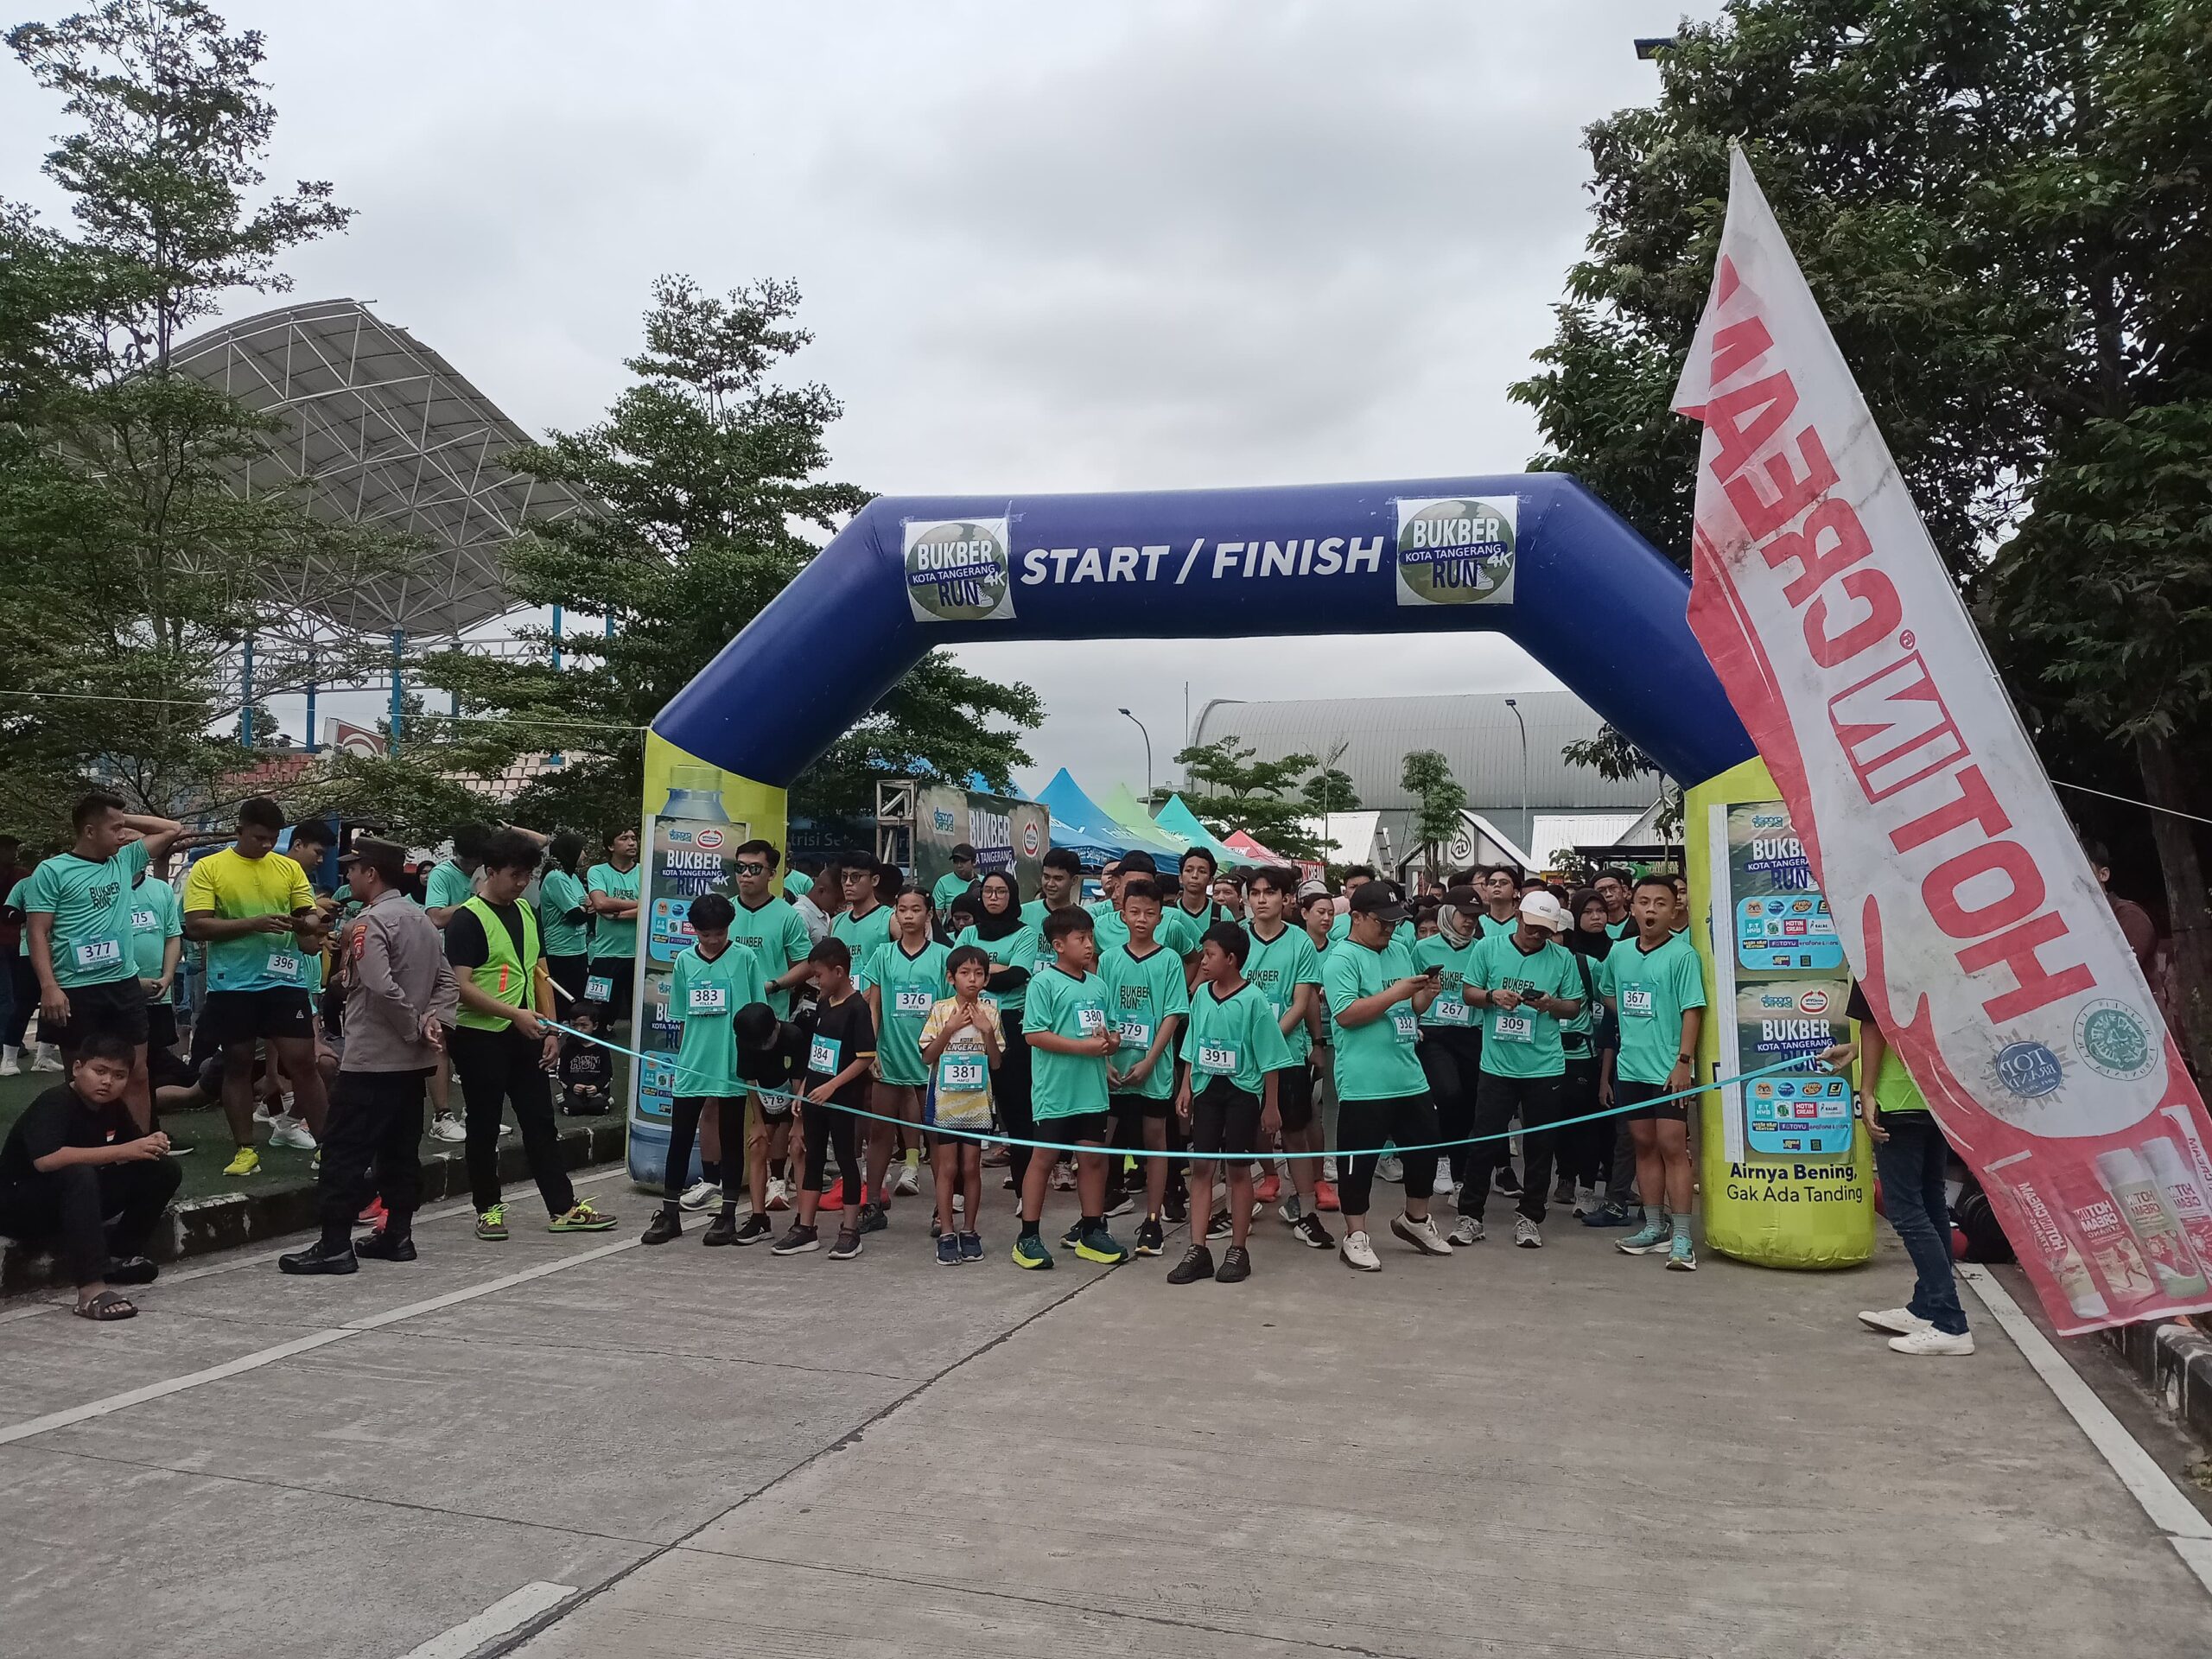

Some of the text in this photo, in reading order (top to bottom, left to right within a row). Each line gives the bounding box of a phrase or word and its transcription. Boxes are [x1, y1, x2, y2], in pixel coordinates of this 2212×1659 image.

[1412, 518, 1500, 549] BUKBER
[918, 539, 993, 570] BUKBER
[1405, 543, 1503, 563] KOTA TANGERANG
[1020, 536, 1385, 585] START / FINISH
[1486, 551, 1514, 570] 4K
[912, 563, 995, 585] KOTA TANGERANG
[983, 569, 1007, 588] 4K
[1433, 559, 1478, 588] RUN
[938, 580, 979, 607] RUN
[968, 810, 1011, 849] BUKBER
[666, 849, 722, 870] BUKBER
[980, 849, 1013, 863] TANGERANG
[678, 869, 723, 878] TANGERANG
[1747, 862, 1770, 871] KOTA
[1771, 868, 1808, 891] RUN
[677, 877, 709, 897] RUN
[84, 942, 111, 958] 377
[273, 956, 295, 969] 396
[1247, 969, 1280, 982] BUKBER
[1439, 969, 1465, 982] BUKBE
[590, 983, 604, 994] 371
[1503, 976, 1535, 991] BUKBER
[695, 989, 718, 1001] 383
[1120, 985, 1151, 998] BUKBER
[1626, 991, 1645, 1004] 367
[902, 993, 925, 1006] 376
[1120, 997, 1138, 1010] RUN
[1084, 1010, 1102, 1022] 380
[1442, 1002, 1464, 1016] 267
[1119, 1022, 1141, 1036] 379
[1398, 1016, 1413, 1029] 332
[1502, 1018, 1524, 1031] 309
[1762, 1019, 1831, 1041] BUKBER
[1757, 1038, 1833, 1052] KOTA TANGERANG
[813, 1046, 828, 1061] 384
[1205, 1048, 1227, 1063] 391
[952, 1065, 976, 1078] 381
[762, 1095, 785, 1106] 378
[1730, 1162, 1858, 1183] Airnya Bening,
[1726, 1184, 1863, 1203] Gak Ada Tanding
